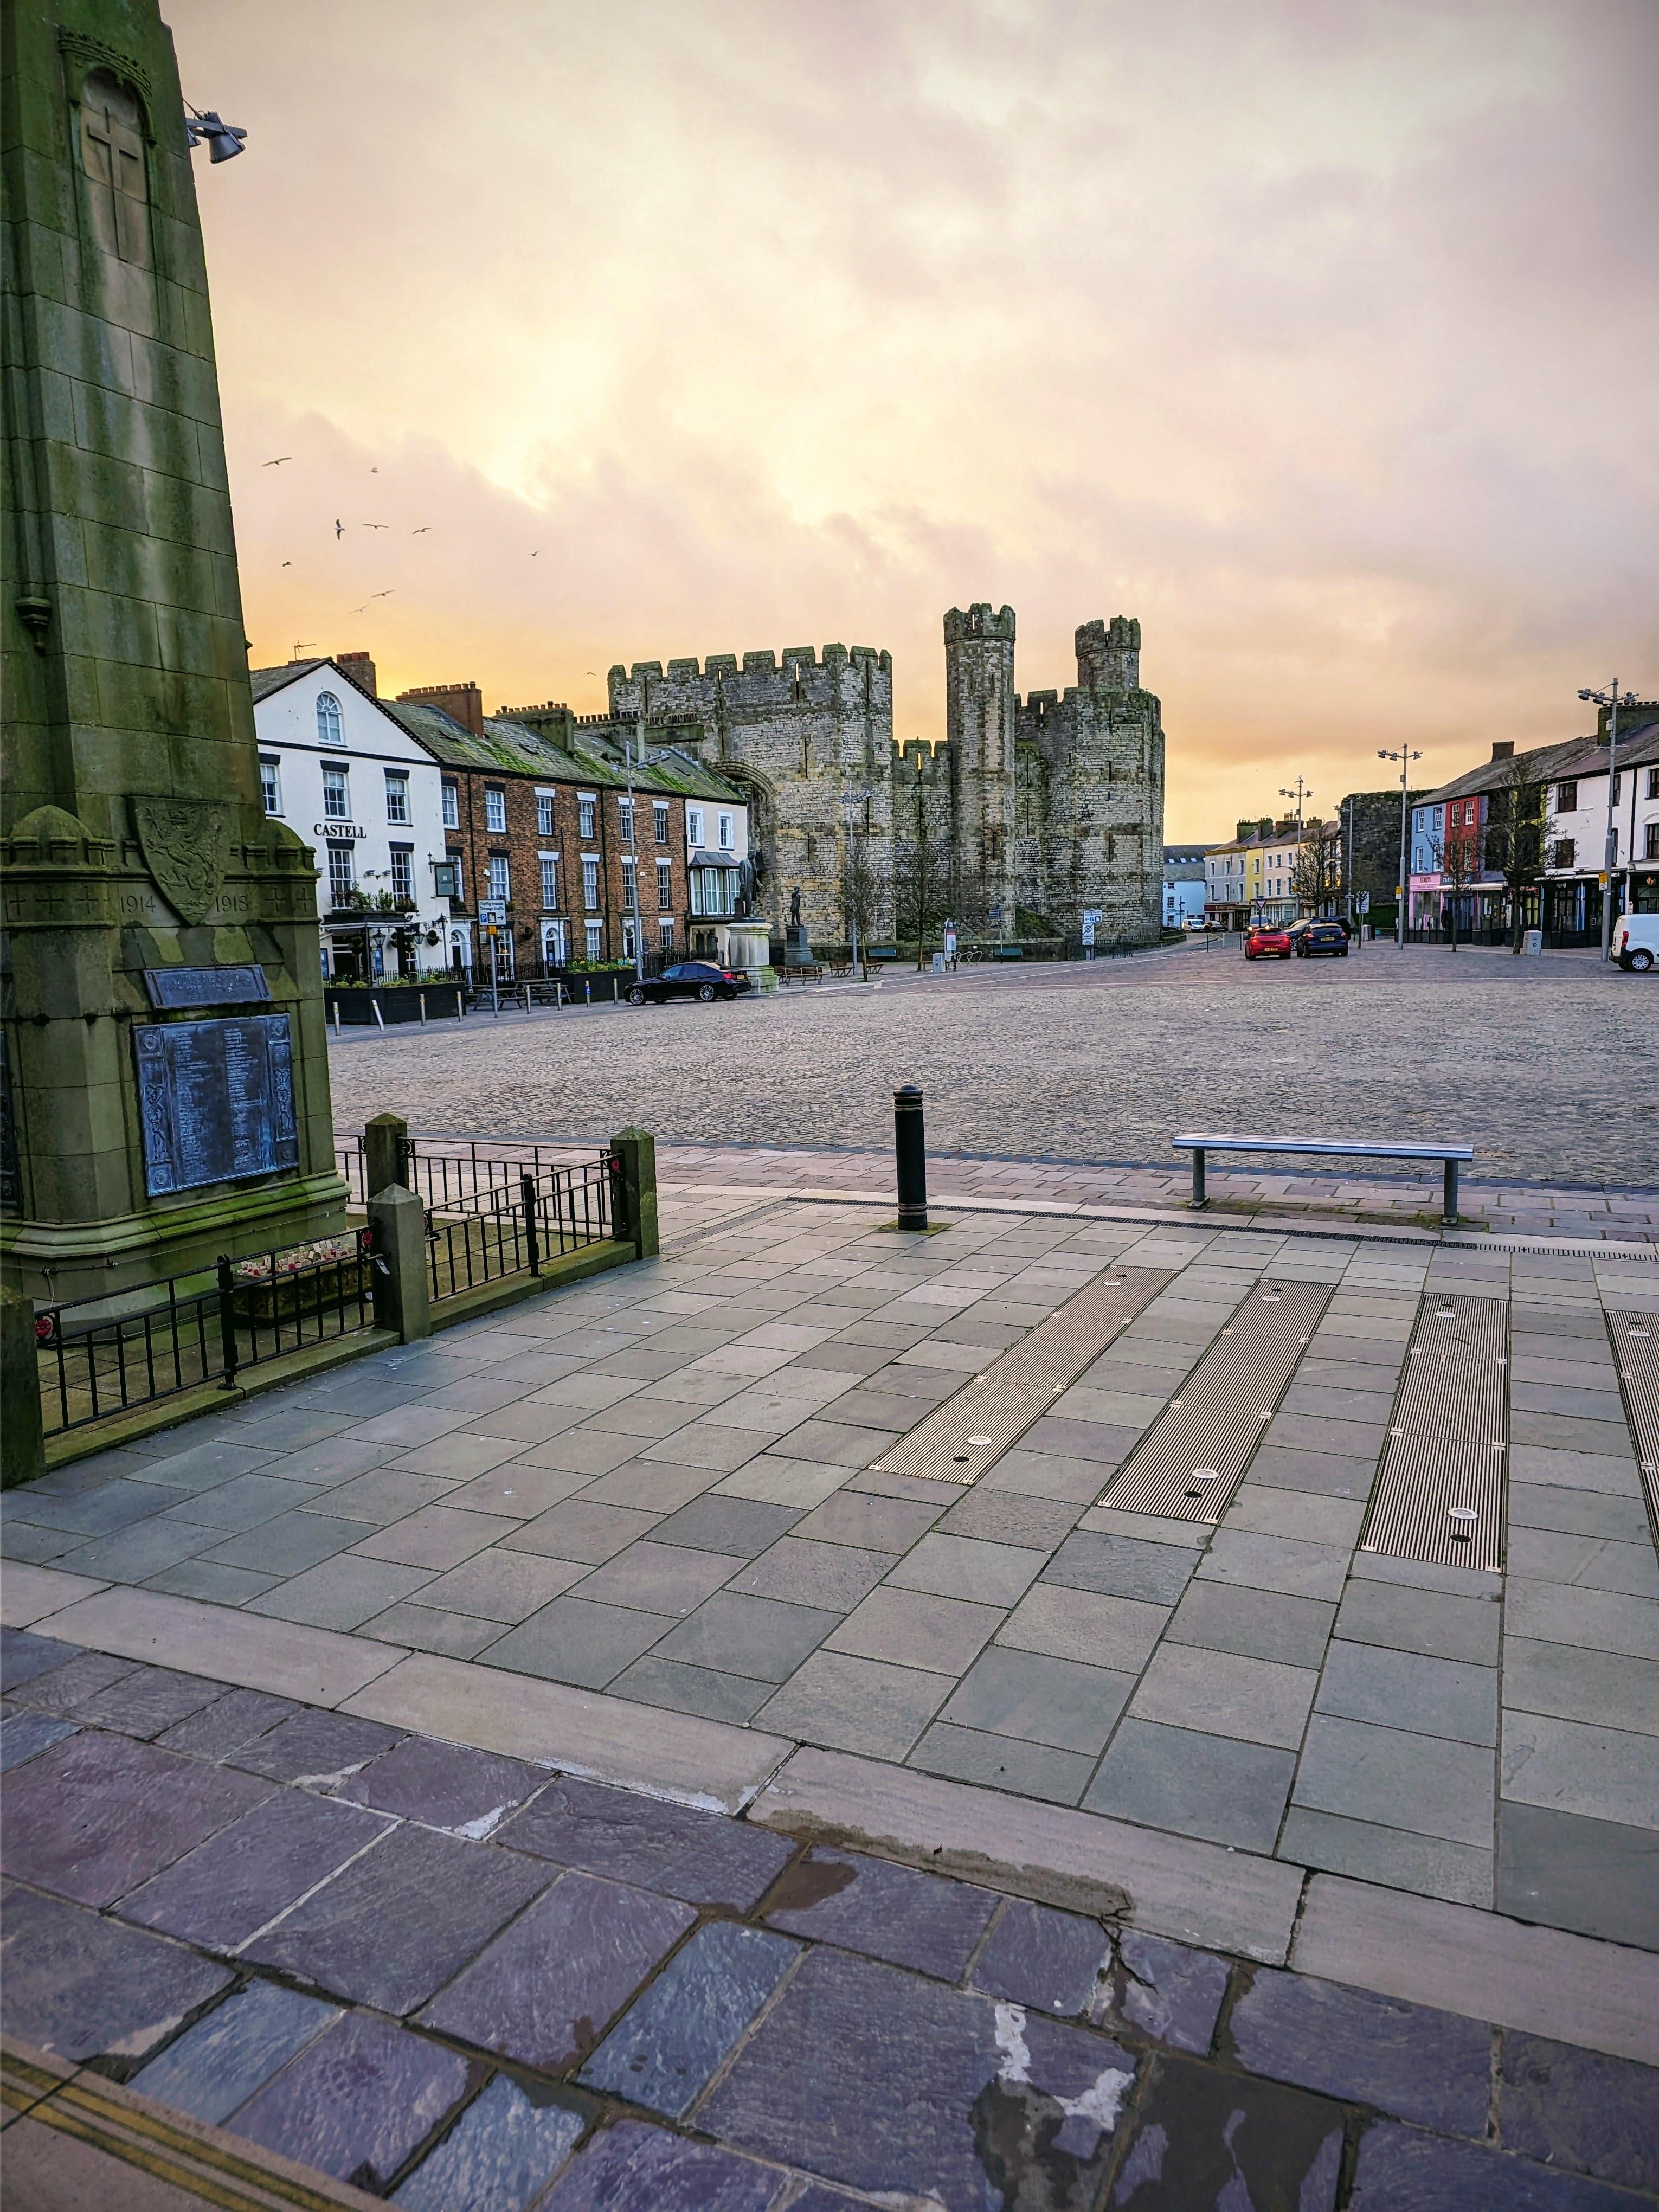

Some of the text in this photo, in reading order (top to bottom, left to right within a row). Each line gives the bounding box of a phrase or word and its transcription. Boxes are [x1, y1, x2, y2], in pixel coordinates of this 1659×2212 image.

[313, 824, 367, 838] CASTELL
[120, 895, 249, 914] 1914 1918
